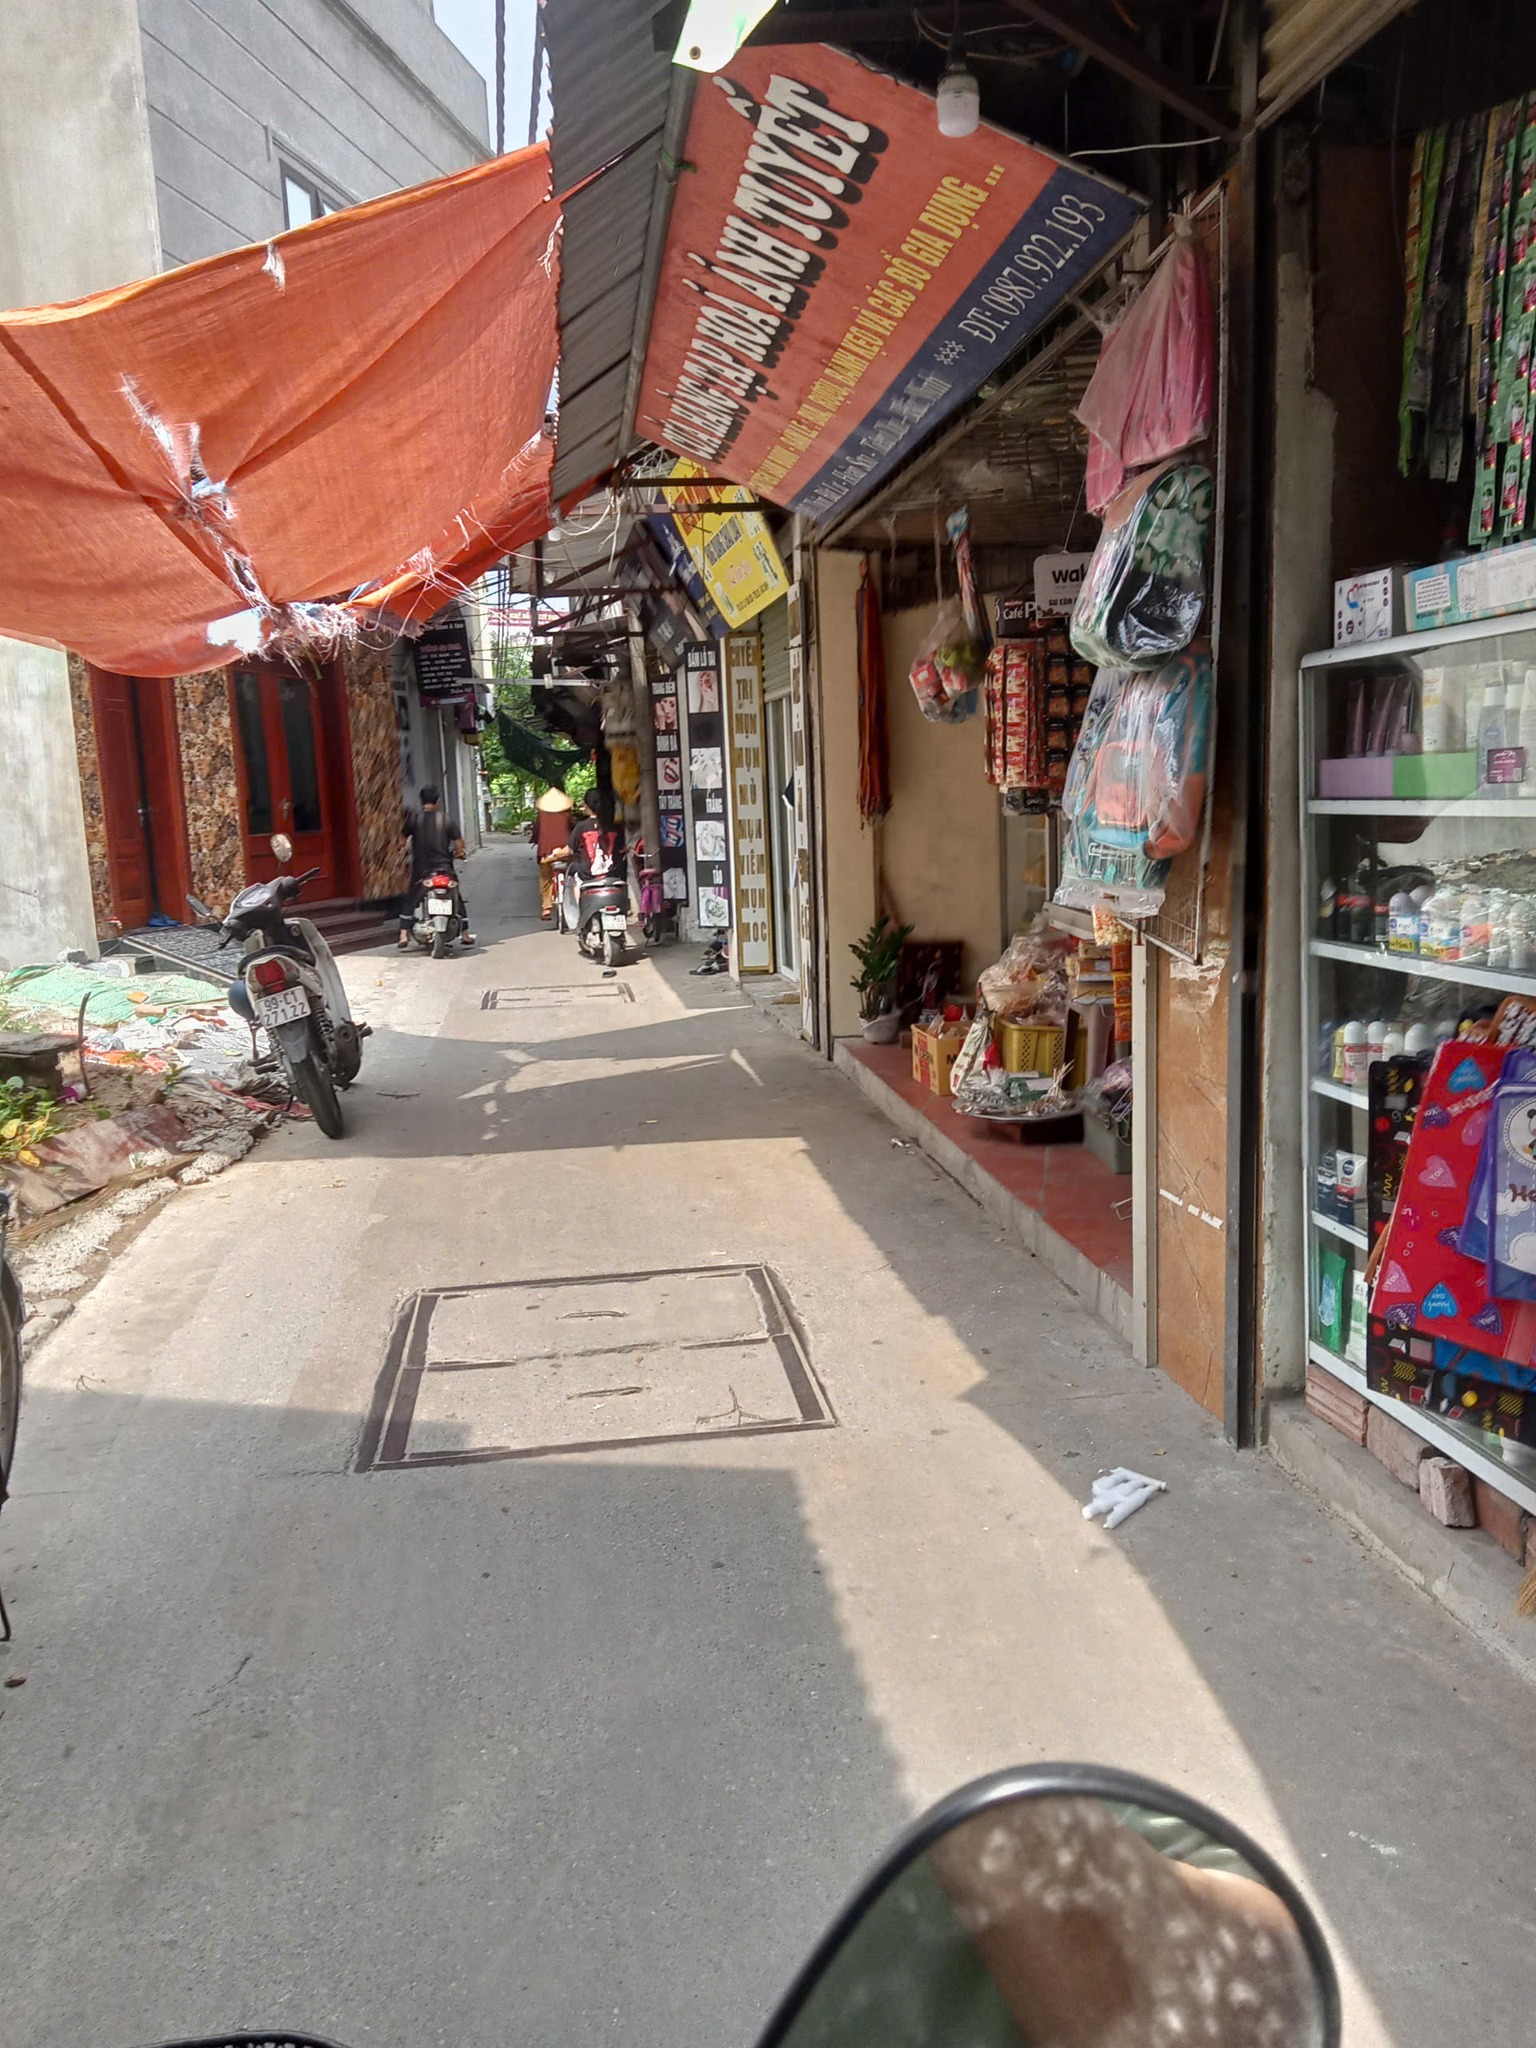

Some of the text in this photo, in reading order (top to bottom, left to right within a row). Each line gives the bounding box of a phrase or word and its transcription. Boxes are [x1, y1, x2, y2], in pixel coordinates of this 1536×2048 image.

[712, 74, 870, 241] TUYẾT
[919, 175, 990, 239] DỤNG
[687, 215, 810, 312] ÁNH
[901, 228, 954, 267] GIA
[981, 193, 1107, 317] 0987.922.193
[880, 249, 932, 291] ĐỒ
[865, 279, 917, 318] CÁC
[682, 278, 781, 363] HOÁ
[853, 306, 898, 336] VÀ
[957, 306, 1010, 345] ĐT:
[841, 326, 887, 359] KẸO
[683, 337, 767, 397] TẠP
[822, 348, 869, 388] BÁNH
[655, 375, 739, 438] HÀNG
[643, 415, 722, 460] CỬA
[1003, 605, 1024, 620] Café
[736, 678, 754, 704] TRỊ
[741, 888, 765, 914] MỤN
[264, 1002, 308, 1027] 271.22
